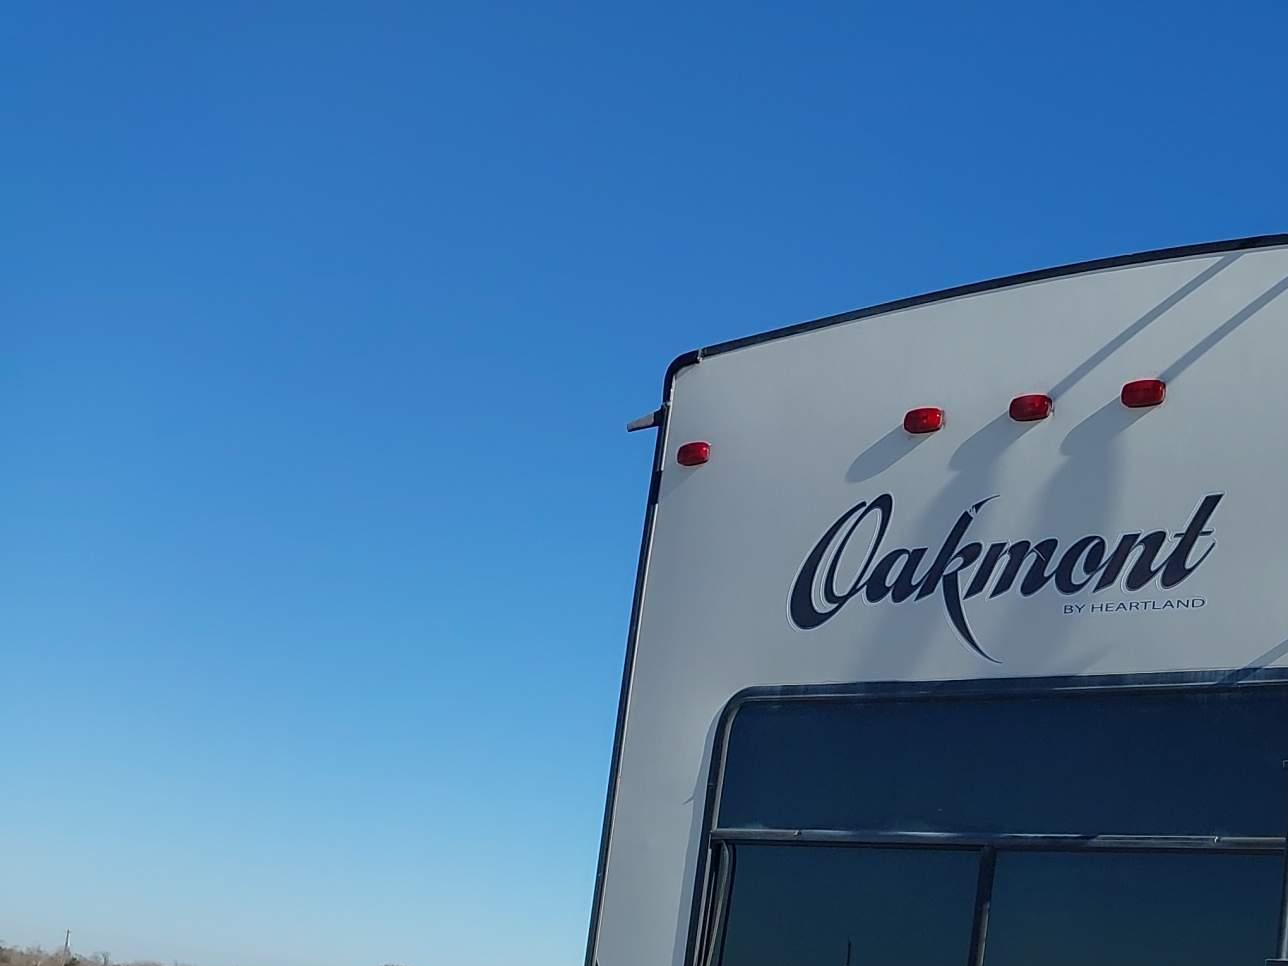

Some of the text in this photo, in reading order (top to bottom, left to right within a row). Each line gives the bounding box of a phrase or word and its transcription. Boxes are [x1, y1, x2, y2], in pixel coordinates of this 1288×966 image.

[790, 493, 1224, 663] Oakmont
[1063, 598, 1206, 614] BY HEARTLAND
